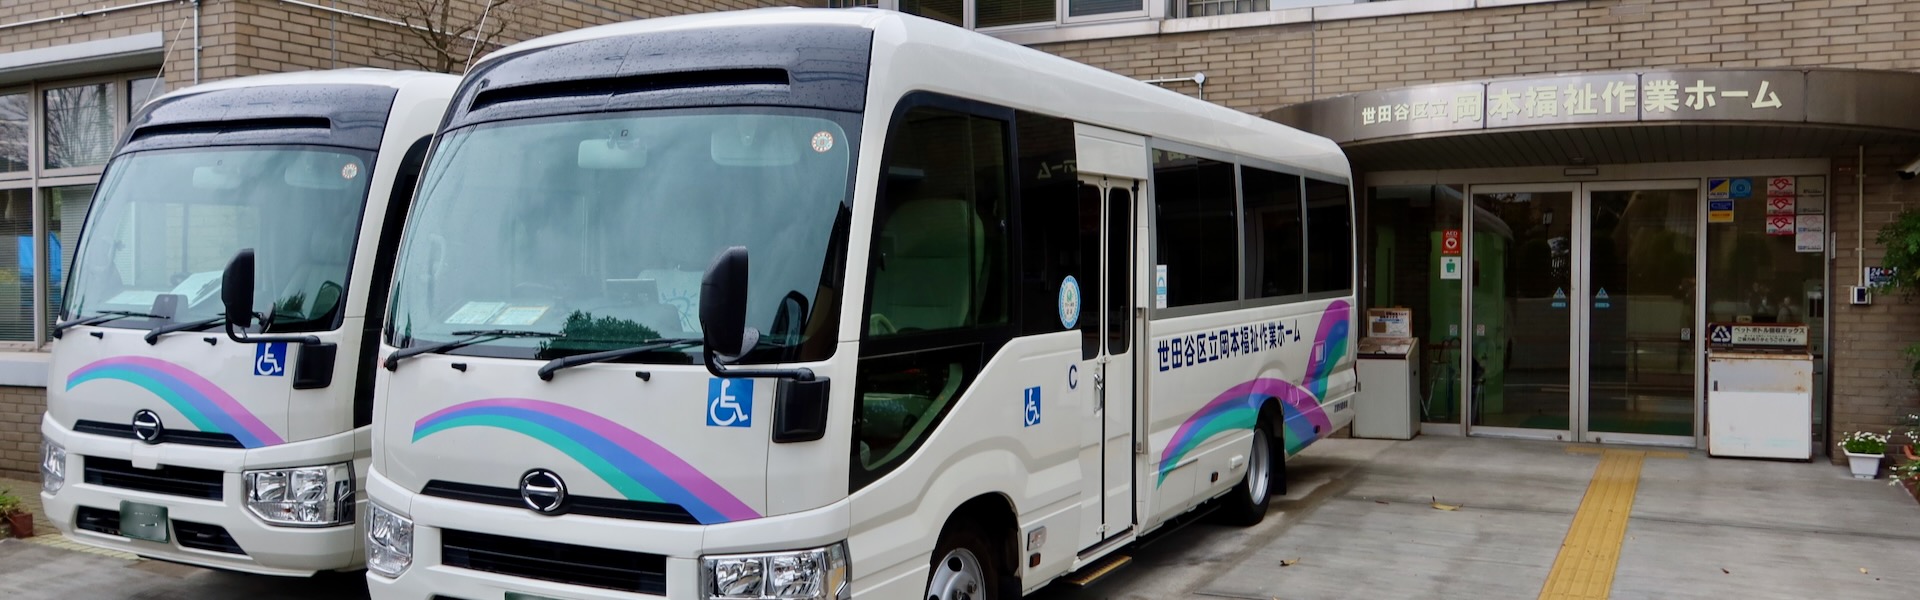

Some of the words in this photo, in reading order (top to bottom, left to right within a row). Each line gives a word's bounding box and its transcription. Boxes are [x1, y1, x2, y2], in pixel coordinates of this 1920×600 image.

[1361, 80, 1782, 125] 世田谷区立岡本福祉作業ホーム
[1157, 319, 1301, 372] 世田谷区立岡本福祉作業ホーム
[1068, 364, 1078, 390] C
